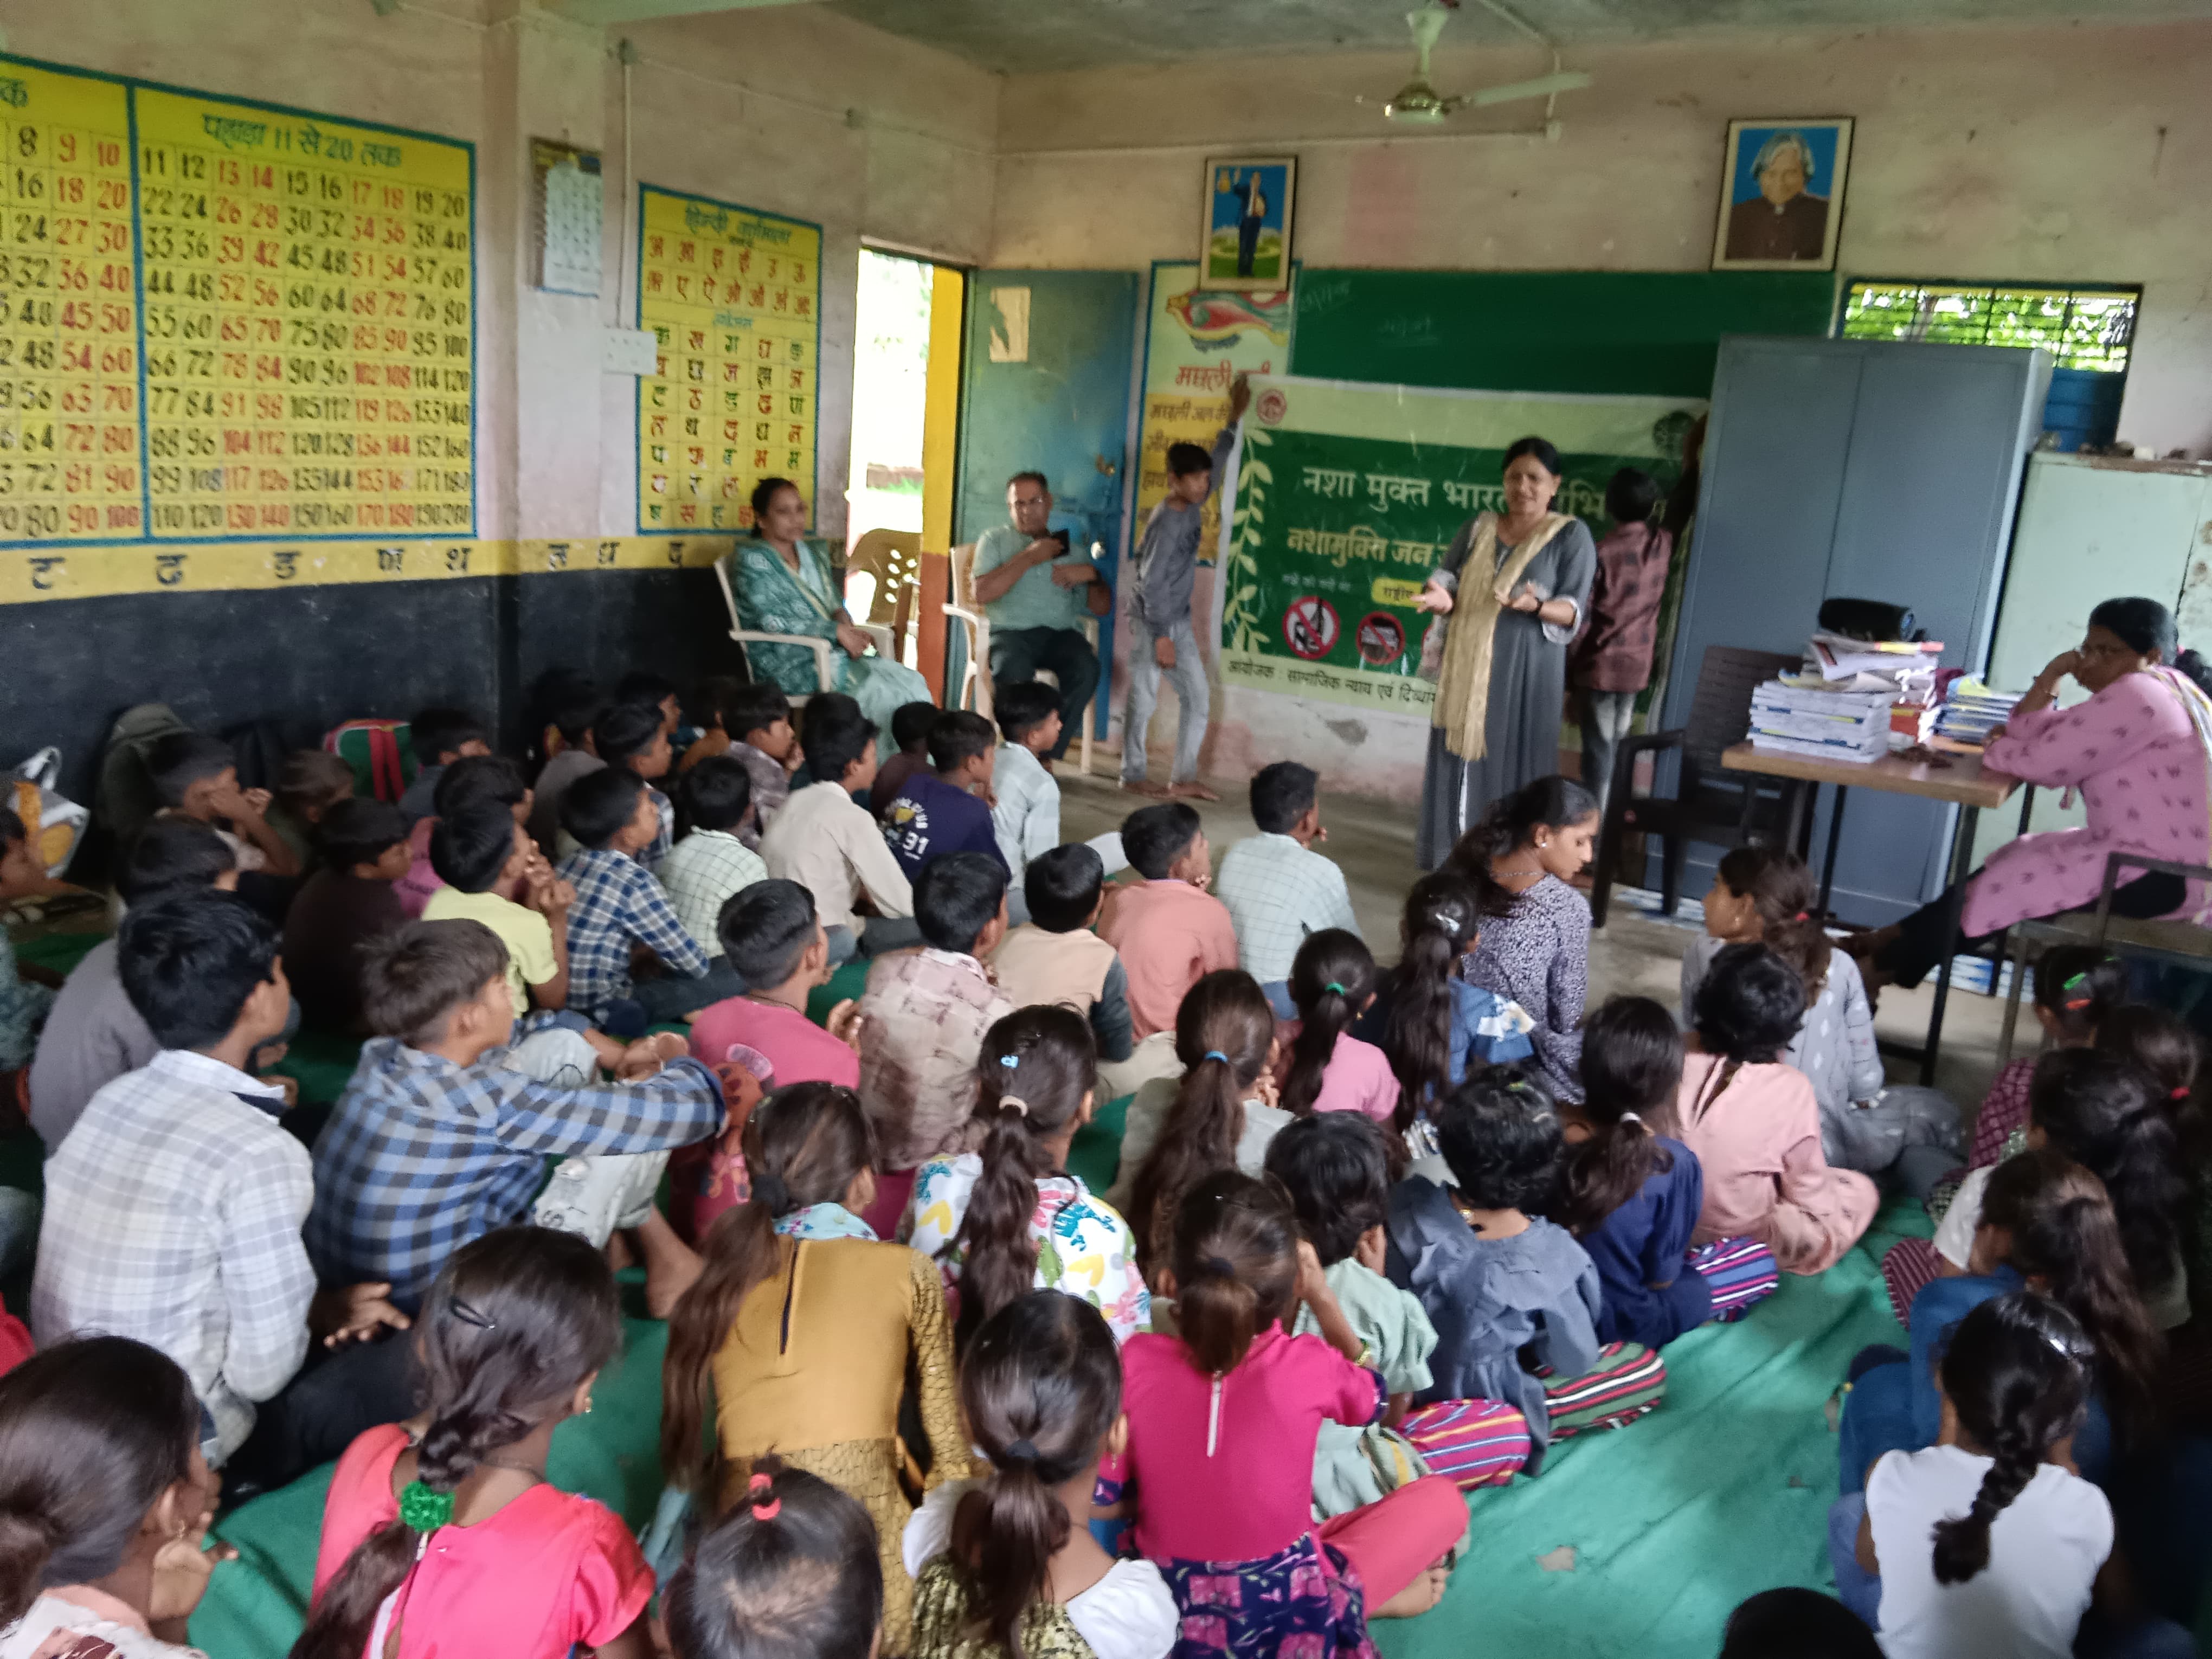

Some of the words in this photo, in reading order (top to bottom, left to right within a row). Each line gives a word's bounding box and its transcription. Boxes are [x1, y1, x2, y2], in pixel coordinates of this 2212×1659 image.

[18, 126, 38, 157] 8
[59, 133, 76, 163] 9
[97, 141, 120, 166] 10
[325, 133, 353, 163] 20
[16, 167, 44, 198] 16
[57, 176, 83, 203] 18
[97, 179, 127, 210] 20
[145, 146, 164, 176] 11
[182, 152, 205, 180] 12
[218, 159, 239, 185] 13
[253, 165, 273, 190] 14
[286, 170, 309, 195] 15
[319, 174, 343, 200] 16
[353, 179, 372, 204] 17
[442, 191, 465, 217] 20
[143, 185, 173, 216] 22
[217, 196, 242, 224] 26
[285, 205, 312, 236] 30
[317, 209, 345, 238] 32
[56, 217, 88, 245] 27
[96, 221, 128, 254] 30
[144, 226, 174, 259] 33
[180, 228, 210, 260] 36
[351, 250, 374, 278] 51
[413, 255, 439, 285] 57
[15, 255, 50, 289] 32
[57, 258, 89, 291] 36
[99, 264, 131, 293] 40
[218, 273, 245, 301] 52
[288, 281, 313, 308] 60
[19, 299, 53, 326] 40
[62, 301, 94, 330] 45
[99, 303, 131, 333] 50
[146, 305, 177, 339] 55
[183, 313, 213, 340] 60
[21, 339, 55, 370] 48
[61, 340, 92, 371] 54
[101, 346, 133, 373] 60
[147, 349, 177, 377] 66
[187, 349, 214, 377] 72
[20, 381, 53, 410] 56
[61, 383, 93, 412] 63
[102, 384, 133, 412] 70
[150, 385, 180, 415] 77
[186, 390, 214, 418] 84
[221, 391, 246, 417] 91
[22, 422, 54, 453] 64
[65, 423, 95, 452] 72
[187, 427, 216, 456] 96
[24, 462, 57, 491] 72
[65, 463, 93, 493] 81
[104, 464, 135, 493] 90
[1303, 467, 1355, 499] नशा
[1365, 473, 1431, 512] मुक्त
[26, 504, 60, 537] 80
[68, 503, 99, 533] 90
[1288, 525, 1389, 568] नशामुक्ति
[1392, 539, 1435, 567] जन
